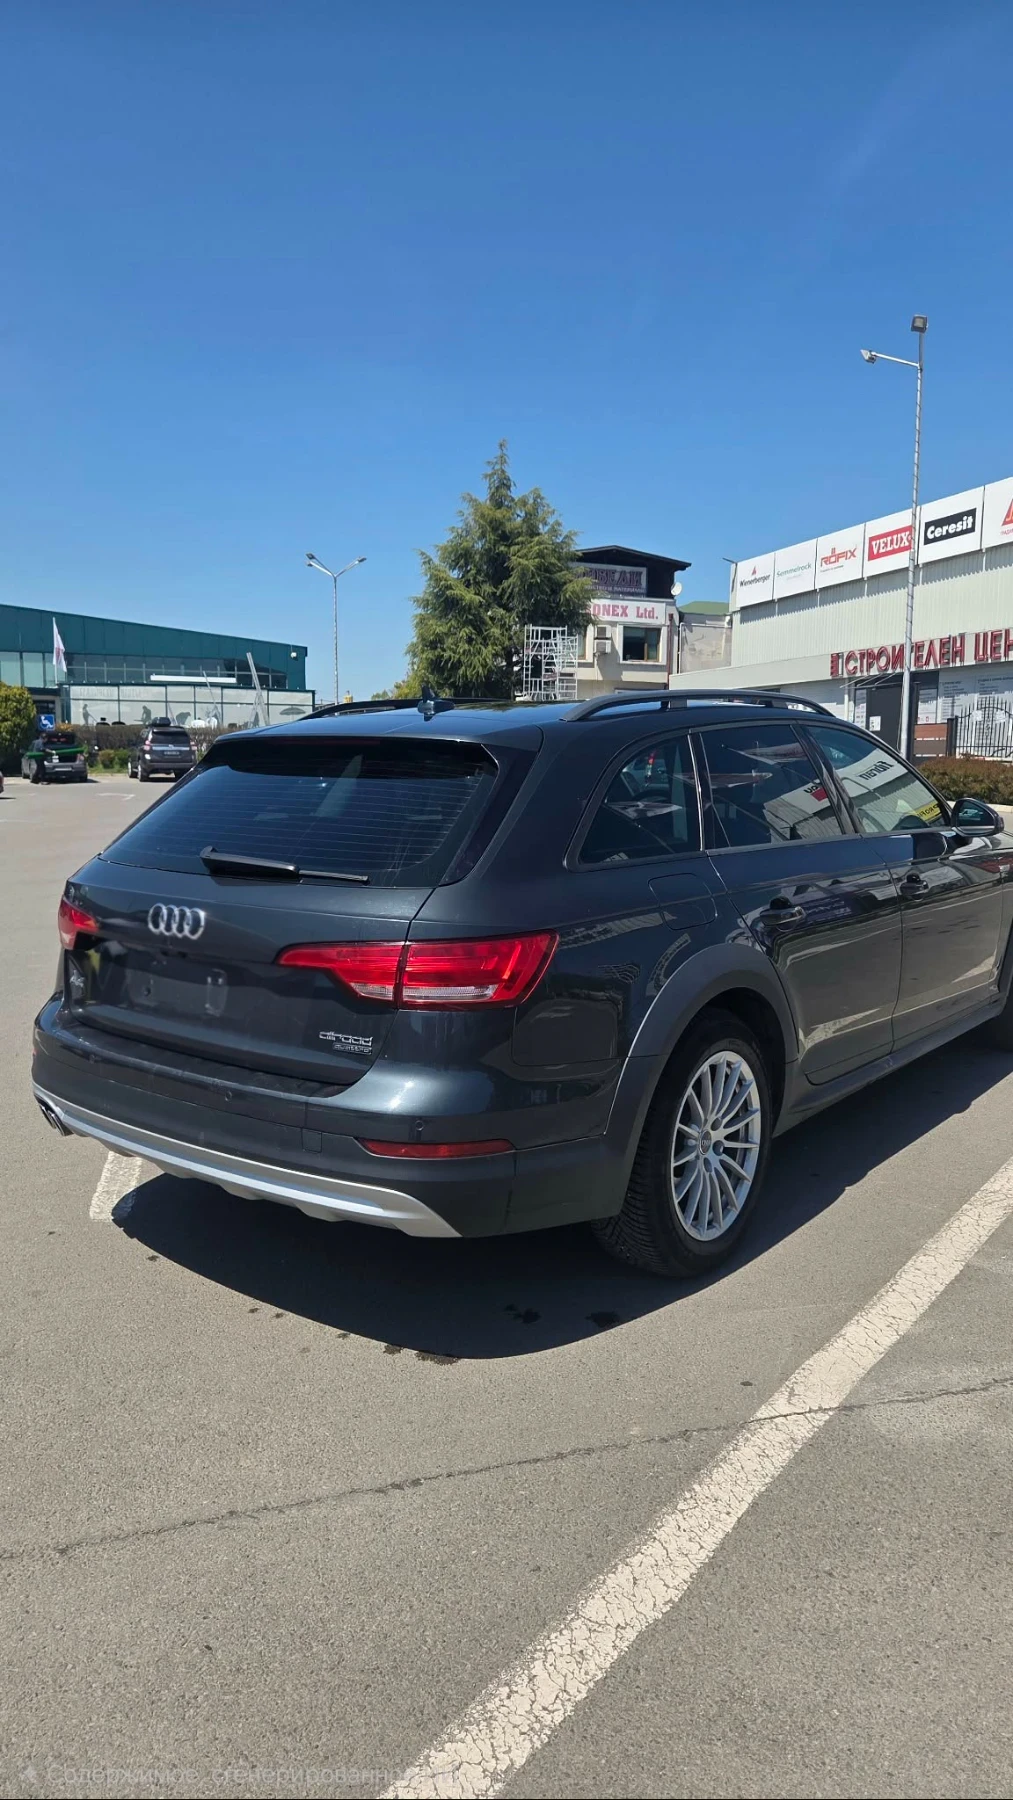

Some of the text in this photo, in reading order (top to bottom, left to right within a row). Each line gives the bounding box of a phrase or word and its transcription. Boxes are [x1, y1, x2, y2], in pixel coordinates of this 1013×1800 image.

[926, 515, 974, 540] Ceresit
[871, 530, 910, 555] VELUX
[776, 562, 812, 578] Semmelrock
[740, 574, 771, 588] Wienerberger
[585, 603, 659, 620] ONEX Ltd.
[844, 633, 966, 676] СТРОИЕЛЕН
[318, 1030, 373, 1047] allroad
